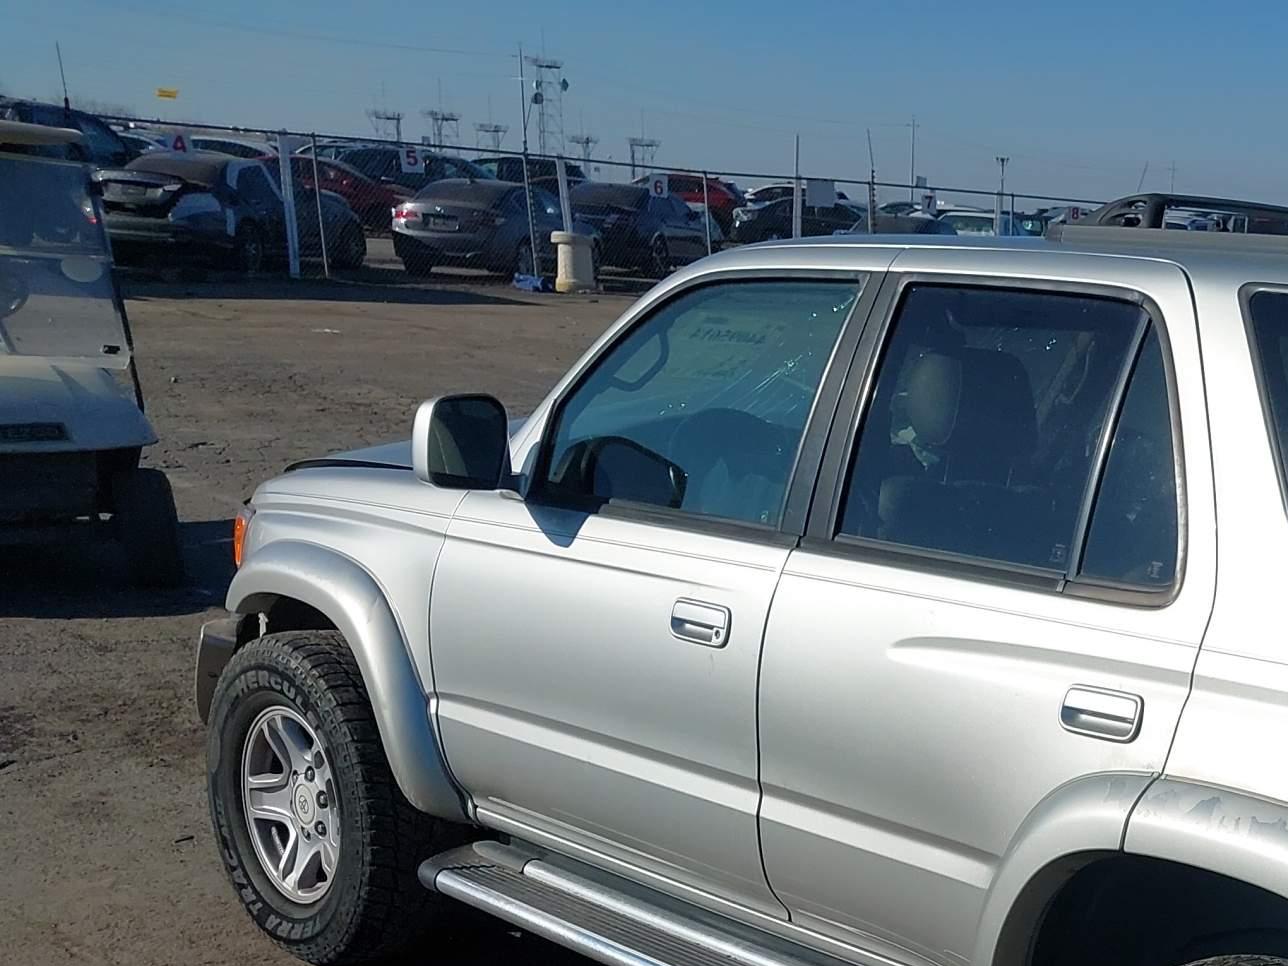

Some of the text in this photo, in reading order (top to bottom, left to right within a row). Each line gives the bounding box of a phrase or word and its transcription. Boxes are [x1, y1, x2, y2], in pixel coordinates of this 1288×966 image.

[405, 149, 418, 167] 5
[654, 180, 664, 196] 6
[924, 195, 934, 209] 7
[1071, 206, 1080, 220] 8
